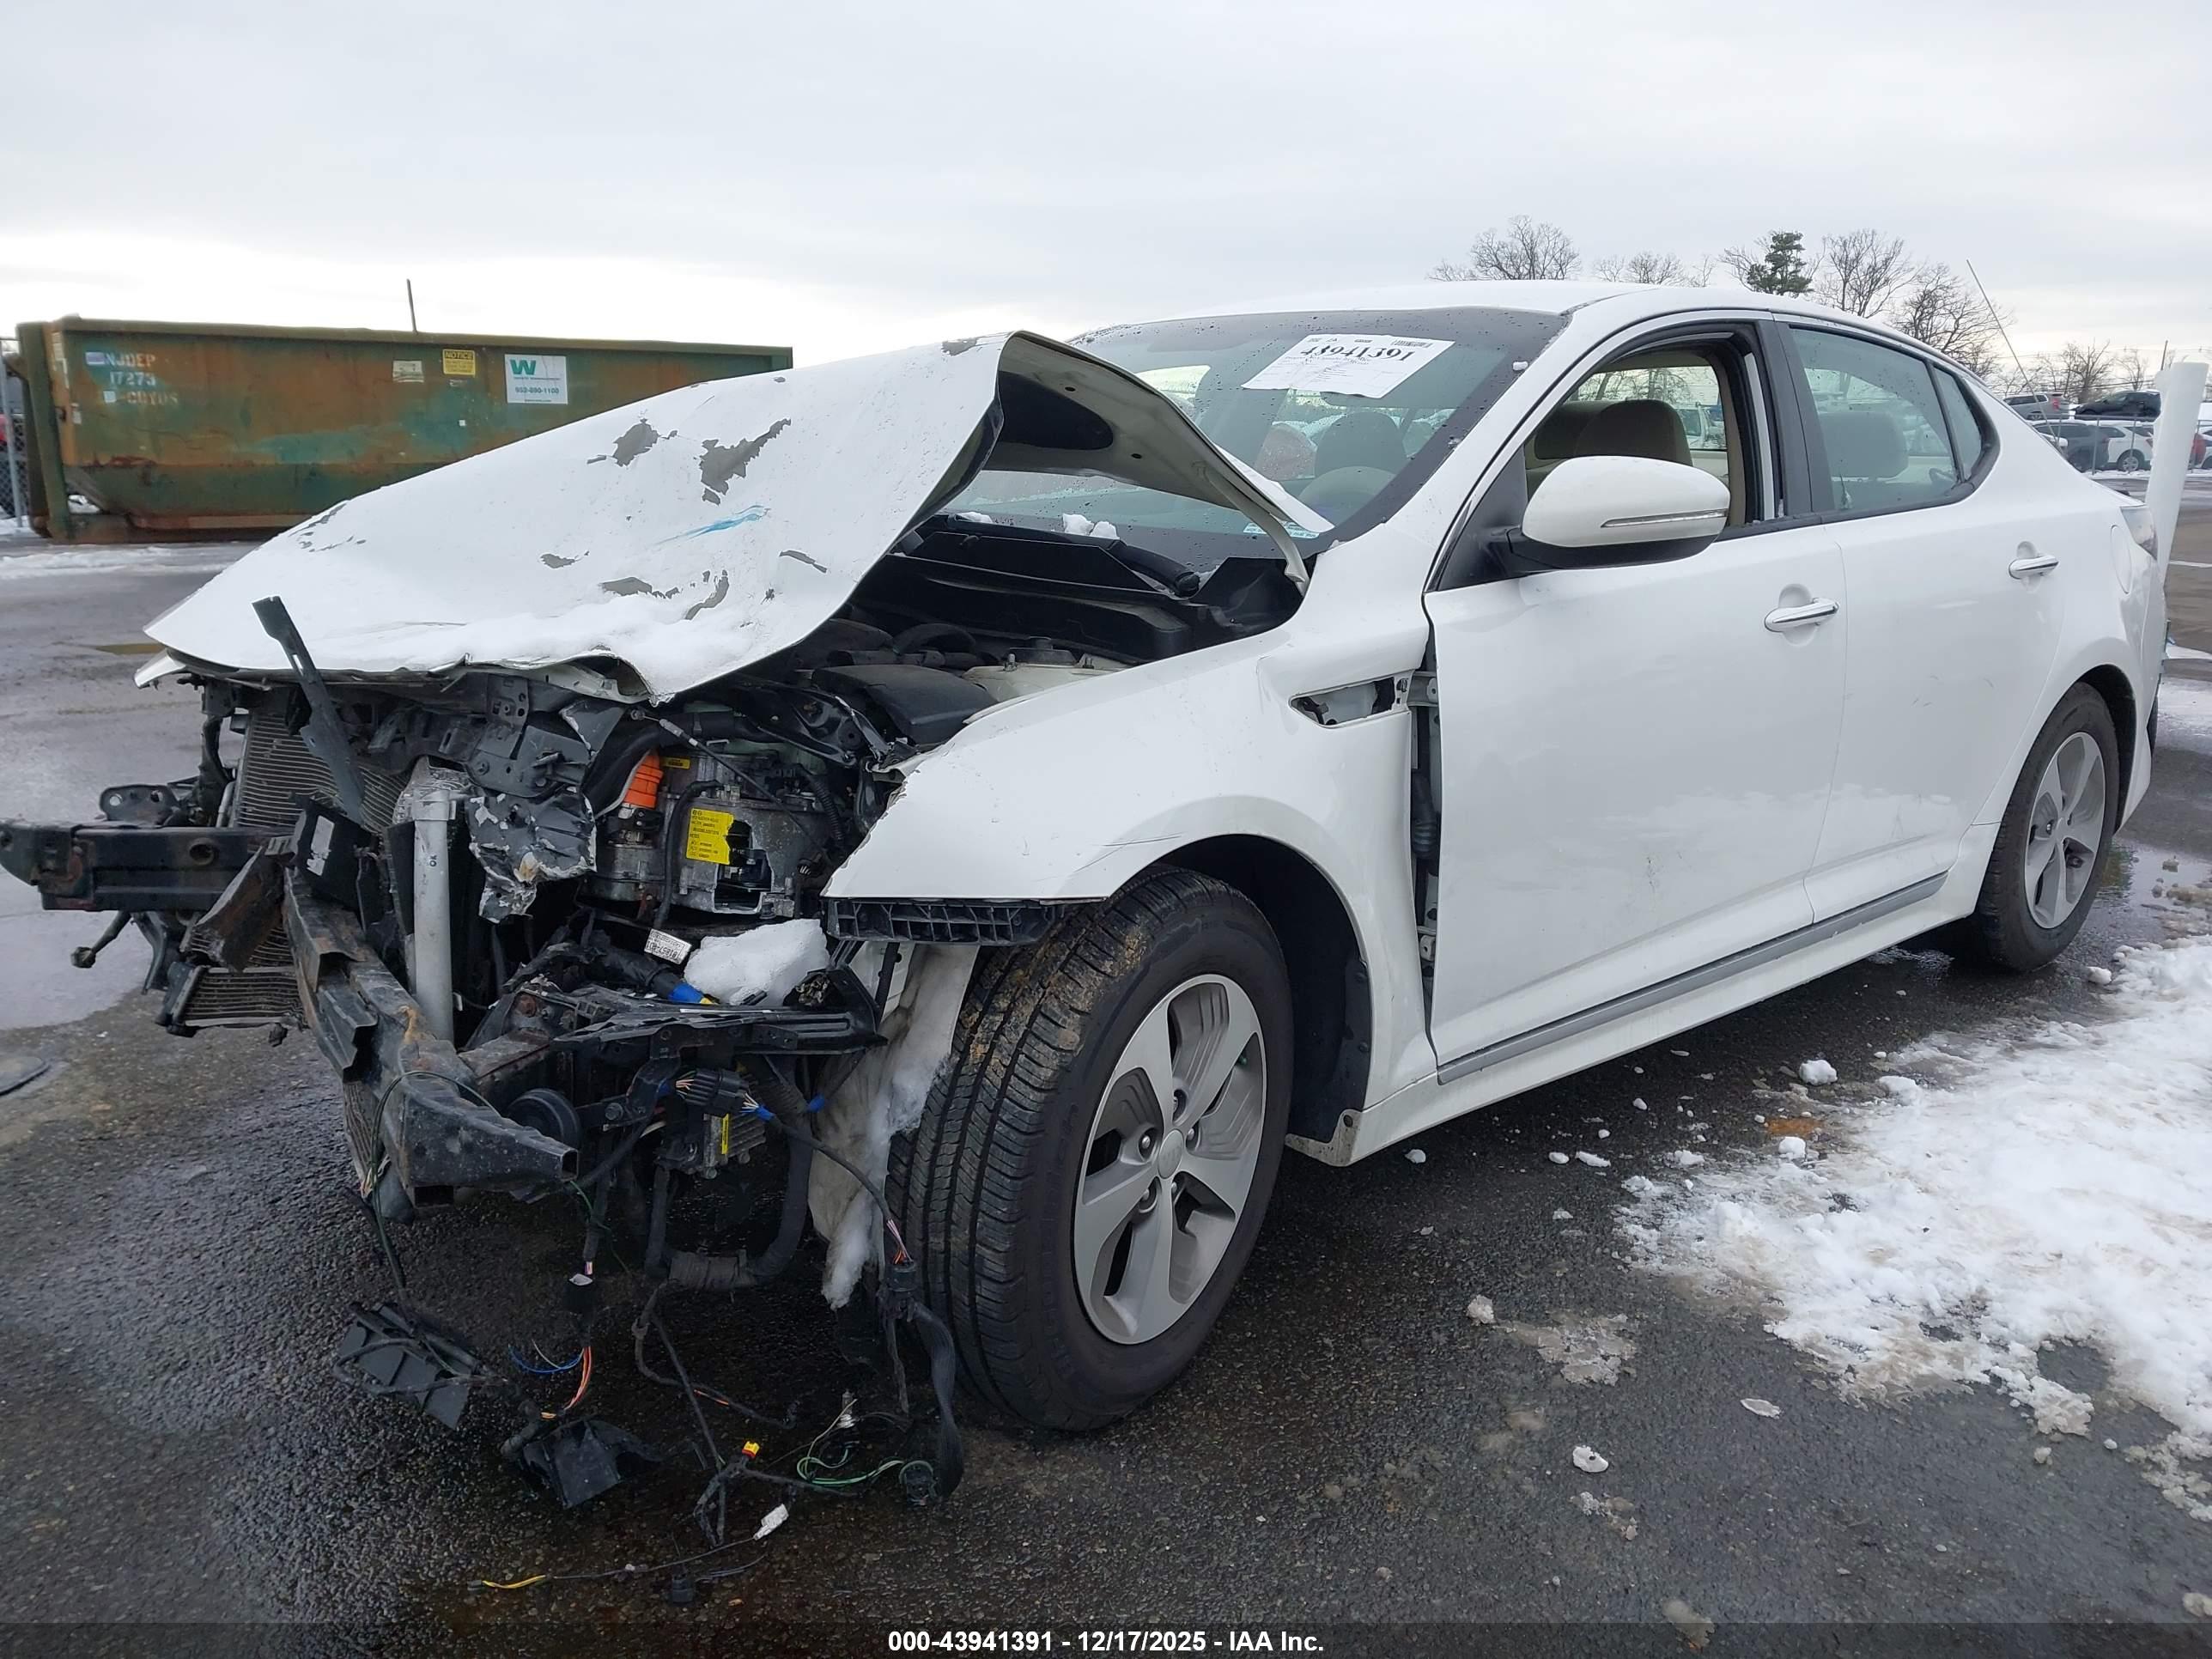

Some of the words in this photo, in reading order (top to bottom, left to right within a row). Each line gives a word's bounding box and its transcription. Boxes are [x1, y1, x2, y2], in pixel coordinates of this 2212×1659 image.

[105, 351, 156, 368] NJDEP
[445, 351, 473, 360] NOTICE
[1300, 344, 1416, 361] 43941391
[509, 358, 537, 376] W
